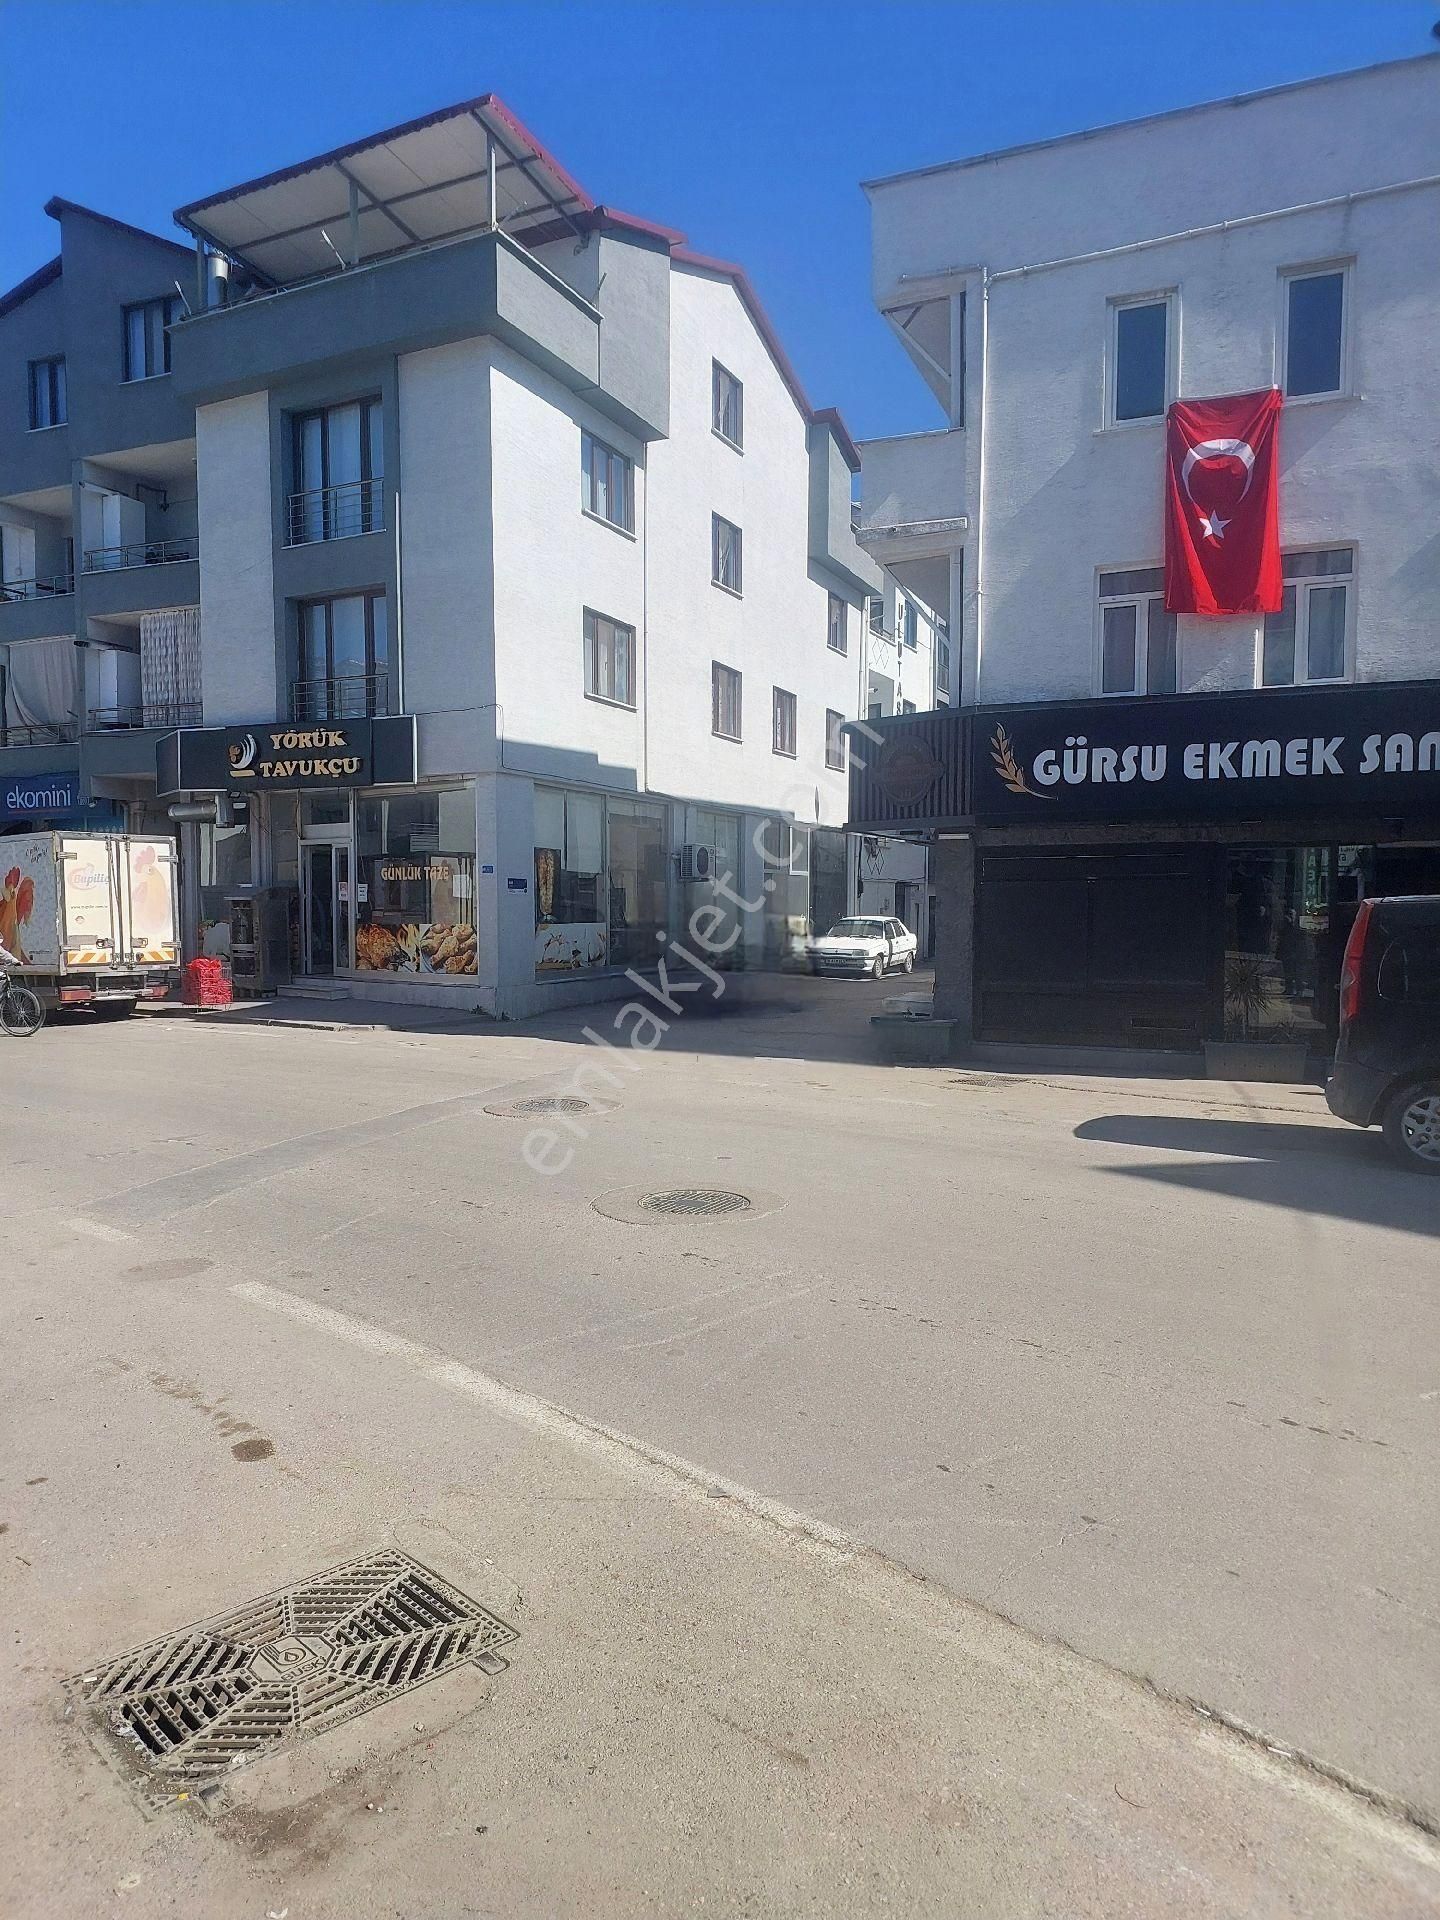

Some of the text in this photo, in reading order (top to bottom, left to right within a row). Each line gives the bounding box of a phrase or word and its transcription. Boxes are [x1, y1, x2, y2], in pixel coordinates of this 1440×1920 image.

[270, 728, 347, 749] YÖRÜK
[260, 757, 360, 777] TAVUKÇU
[1033, 736, 1167, 786] GÜRSU
[1183, 736, 1345, 780] EKMEK
[6, 784, 71, 809] ekomini
[381, 864, 449, 880] GÜNLÜK TAZE
